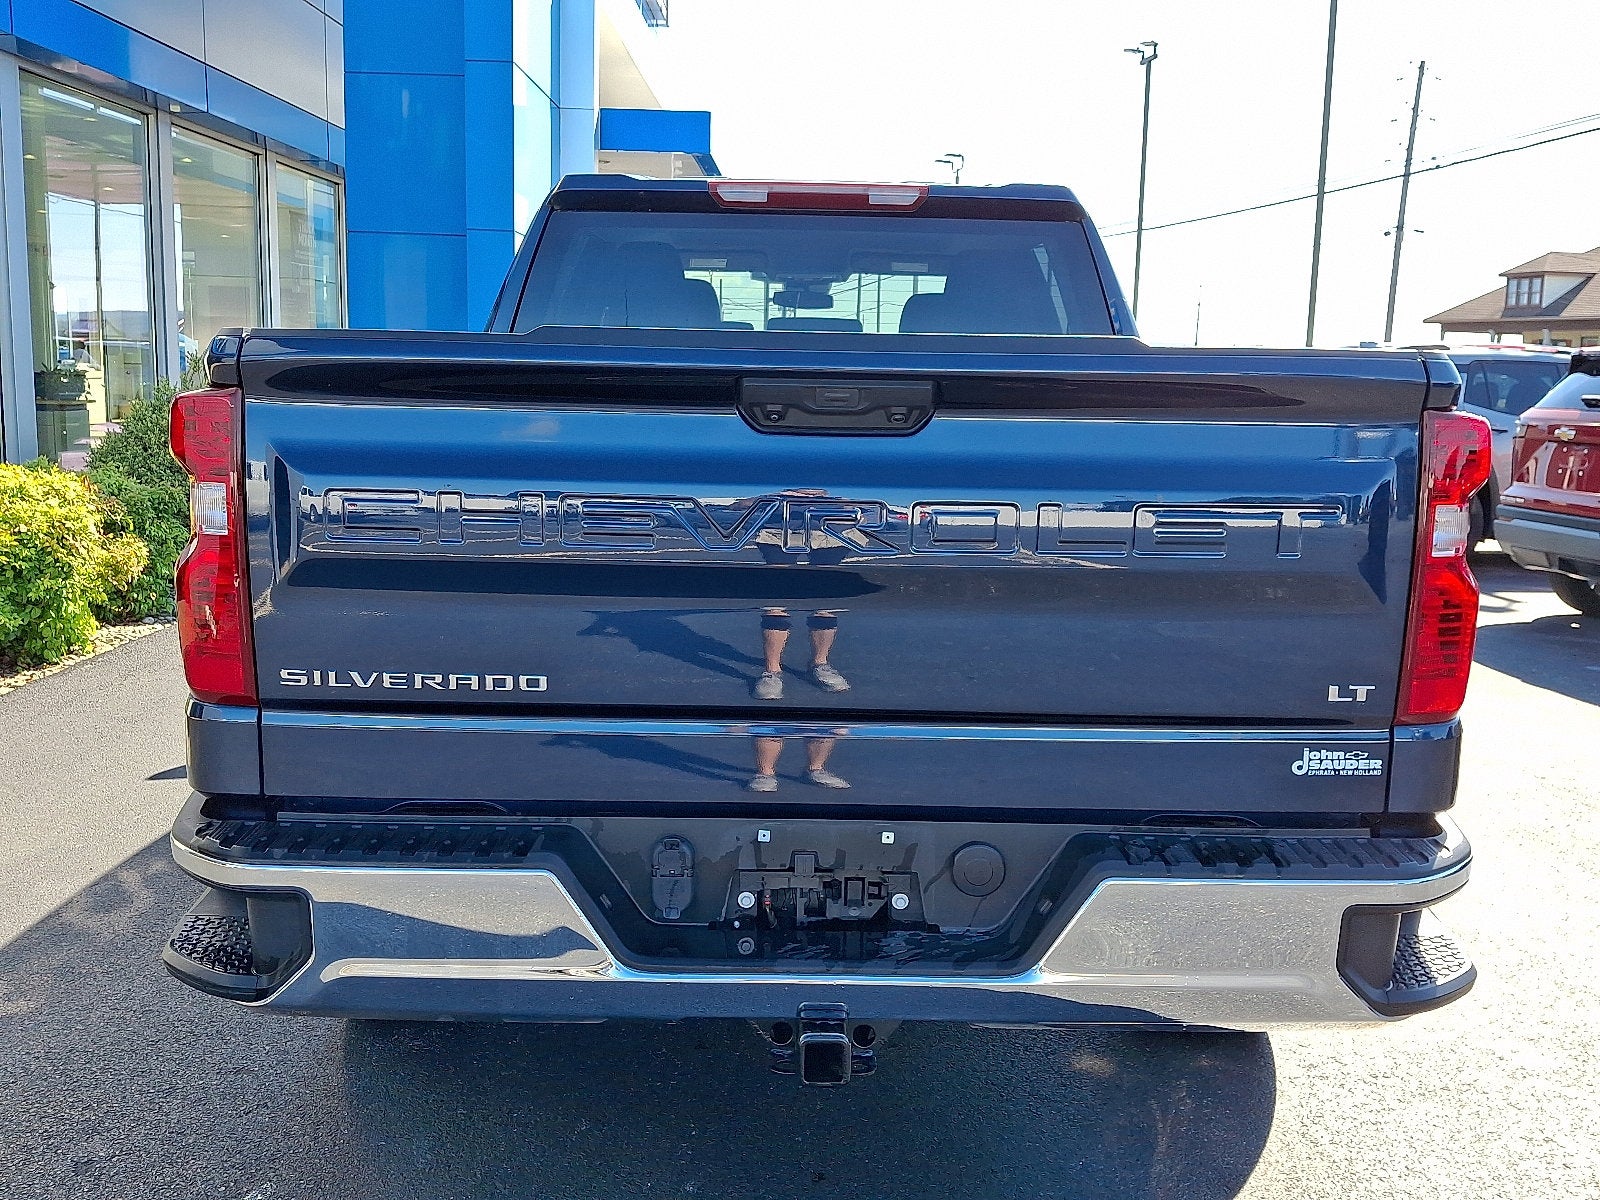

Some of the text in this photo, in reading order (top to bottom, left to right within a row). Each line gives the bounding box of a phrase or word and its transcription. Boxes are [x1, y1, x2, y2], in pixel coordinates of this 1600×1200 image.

[324, 487, 1343, 559] CHEVROLET
[279, 668, 549, 692] SILVERADO
[1328, 685, 1376, 702] LT
[1308, 759, 1383, 770] SAUDER
